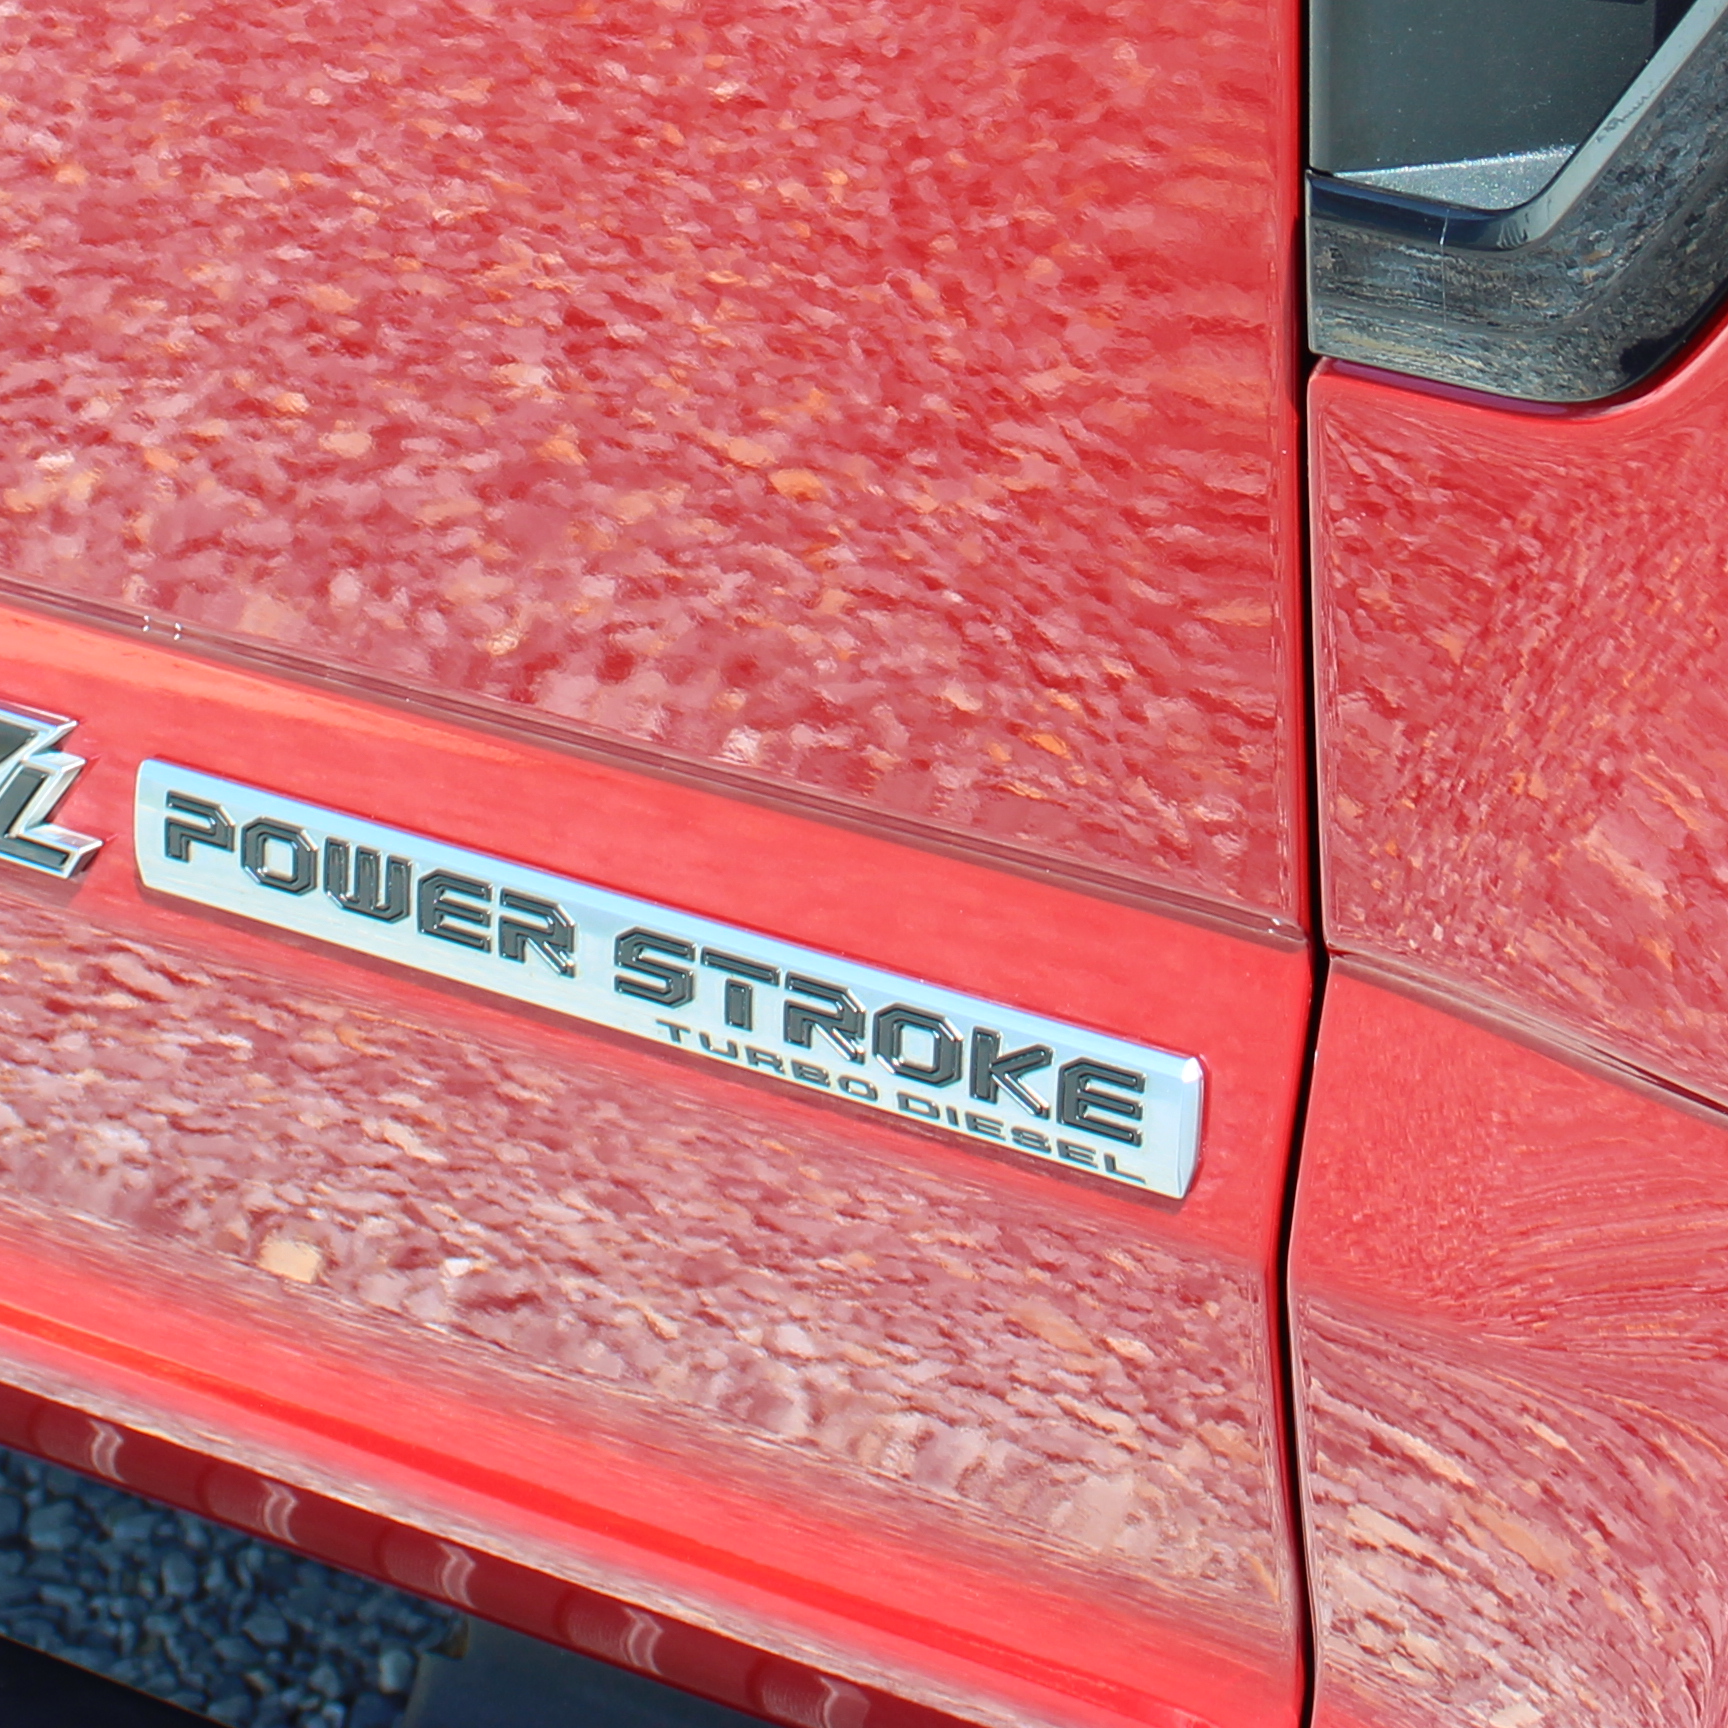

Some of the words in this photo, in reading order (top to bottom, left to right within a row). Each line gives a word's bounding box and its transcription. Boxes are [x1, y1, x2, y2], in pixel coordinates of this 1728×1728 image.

[163, 789, 575, 978] POWER
[613, 925, 1147, 1148] STROKE
[655, 1017, 879, 1103] TURBO
[896, 1090, 1147, 1184] DIESEL
